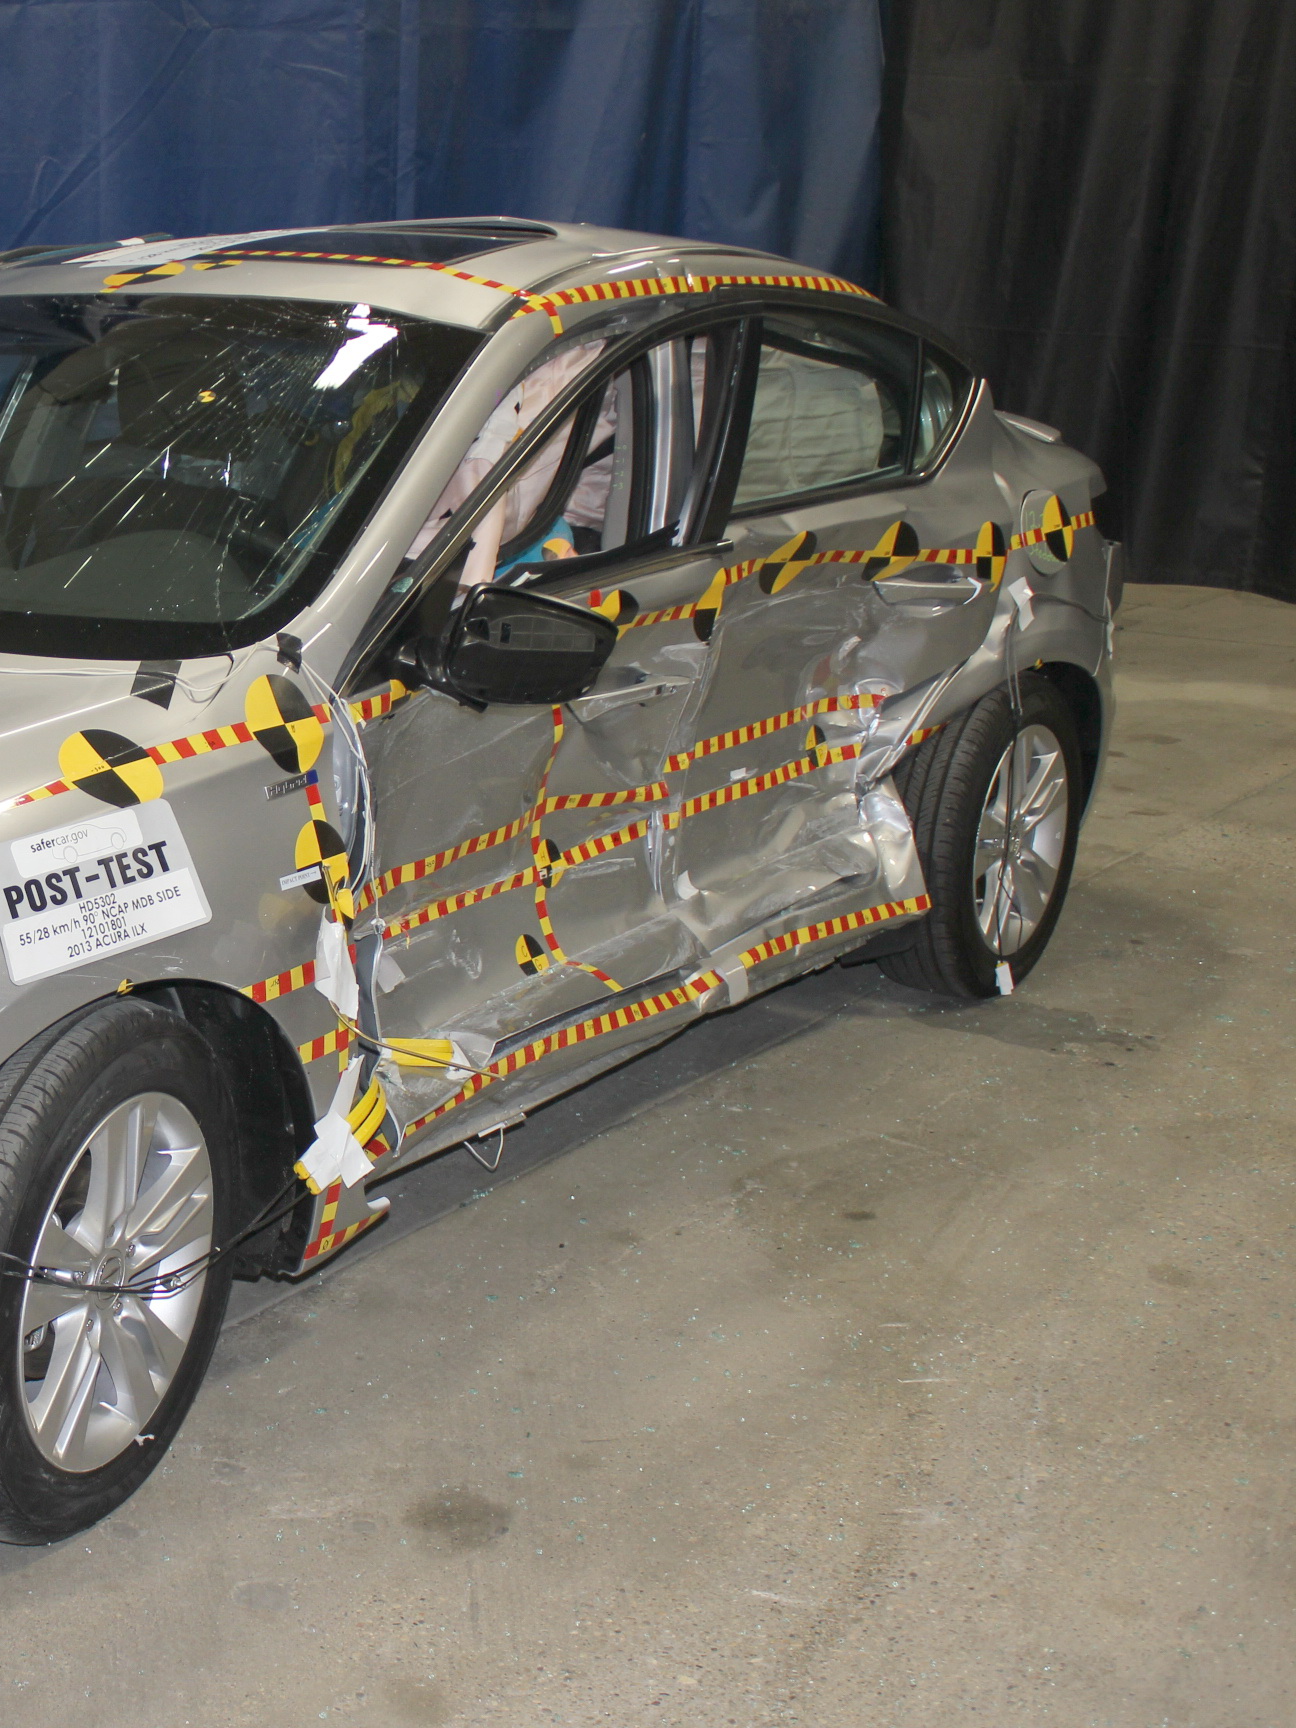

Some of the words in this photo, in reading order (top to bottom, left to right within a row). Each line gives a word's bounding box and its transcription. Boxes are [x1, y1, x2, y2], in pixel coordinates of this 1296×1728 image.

[30, 828, 89, 853] safercar.gov
[3, 840, 170, 920] POST-TEST
[19, 927, 51, 947] 55/28
[53, 919, 81, 936] km/h
[102, 902, 129, 921] NCAP
[132, 894, 155, 910] MDB
[156, 886, 181, 903] SIDE
[78, 892, 118, 914] HD5302
[67, 941, 93, 958] 2013
[95, 929, 131, 950] ACURA
[131, 922, 148, 936] ILX
[81, 916, 127, 940] 12101801
